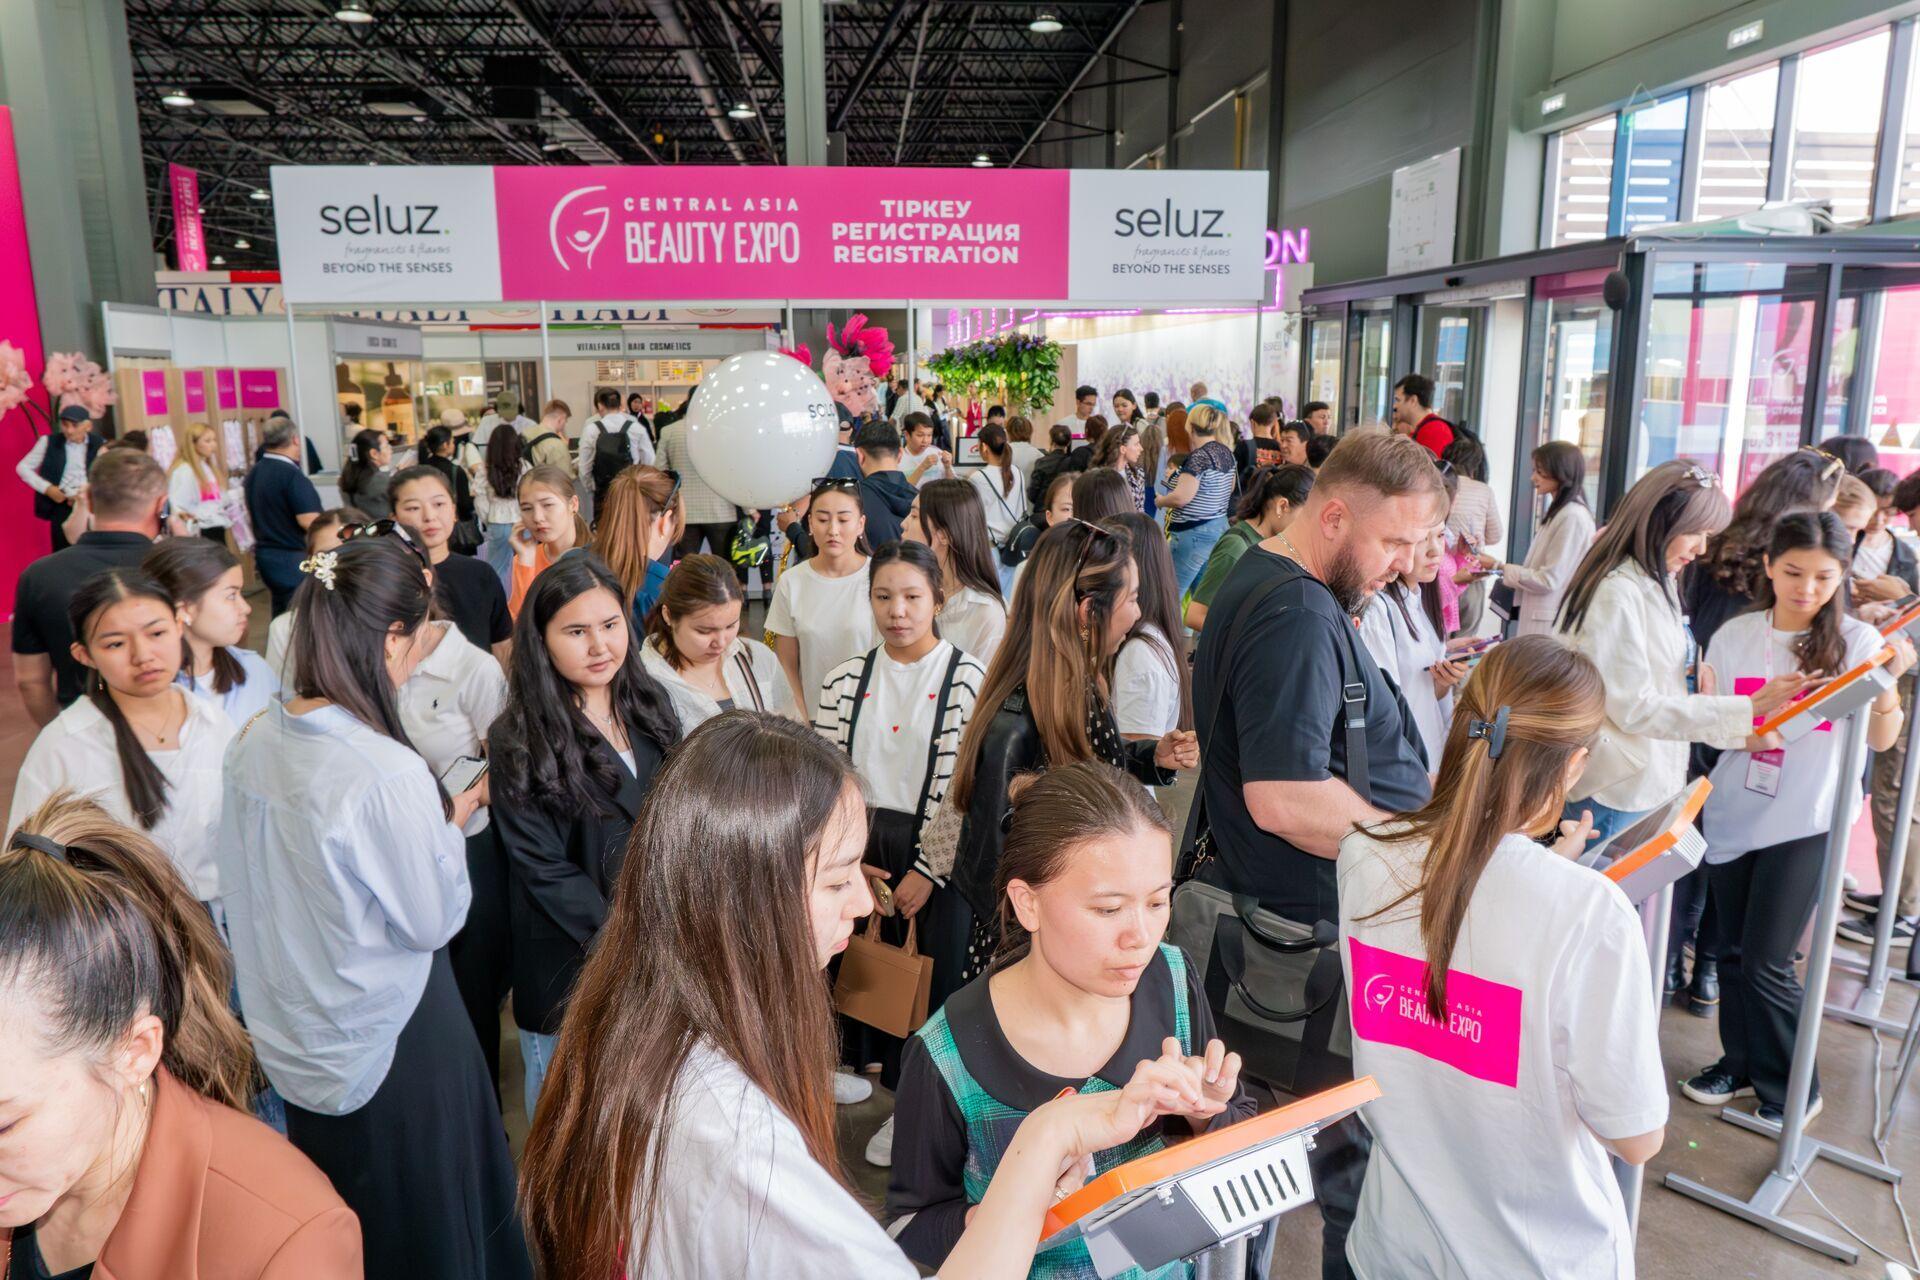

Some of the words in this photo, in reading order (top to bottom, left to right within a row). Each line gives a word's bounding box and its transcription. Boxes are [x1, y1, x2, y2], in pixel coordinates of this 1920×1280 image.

[623, 197, 733, 212] CENTRAL
[743, 197, 799, 212] ASIA
[880, 199, 972, 219] ТІРКЕУ
[831, 222, 1021, 244] РЕГИСТРАЦИЯ
[624, 221, 727, 264] BEAUTY
[733, 221, 800, 264] EXPO
[833, 245, 1019, 264] REGISTRATION
[322, 262, 376, 273] BEYOND
[379, 262, 403, 273] THE
[406, 262, 453, 273] SENSES
[1112, 263, 1161, 274] BEYOND
[1163, 263, 1186, 274] THE
[1188, 263, 1231, 274] SENSES
[627, 342, 646, 351] HAIR
[649, 342, 692, 351] COSMETICS
[1456, 1002, 1483, 1018] ASIA
[1399, 995, 1445, 1031] BEAU
[1449, 1012, 1482, 1044] EXPO
